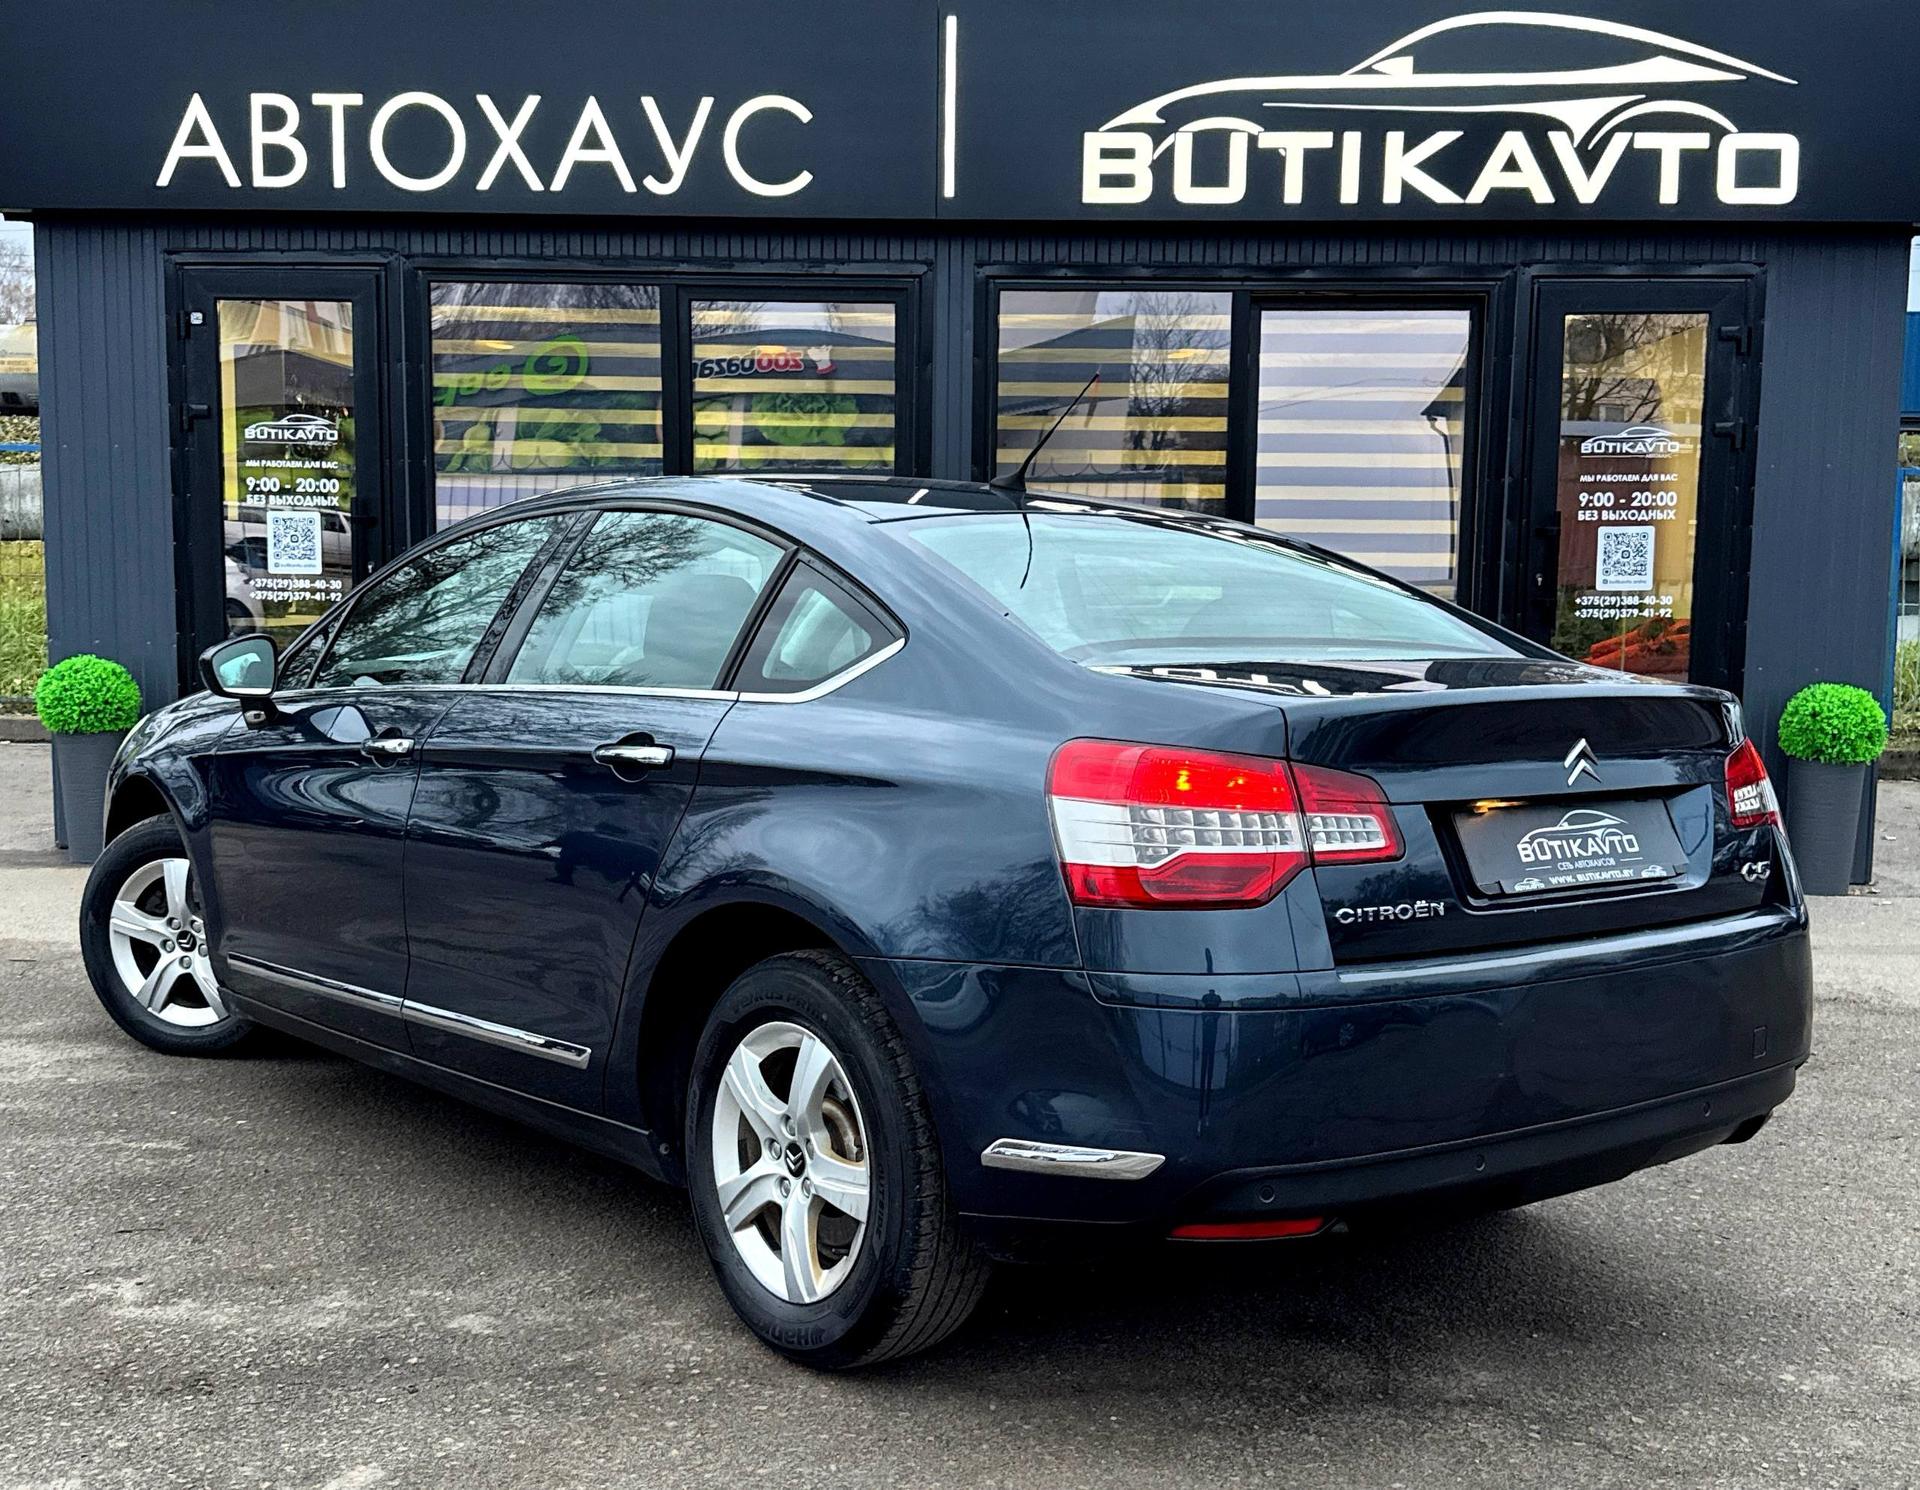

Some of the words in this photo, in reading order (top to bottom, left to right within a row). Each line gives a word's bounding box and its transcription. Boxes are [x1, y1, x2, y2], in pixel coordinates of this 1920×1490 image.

[156, 91, 814, 198] АВТОХАУС
[1081, 131, 1799, 205] BUTIKAVTO
[244, 428, 339, 440] BUTIKAVTO
[1581, 441, 1680, 453] BUTIKAVTO
[321, 461, 339, 469] ВАС
[1580, 474, 1594, 482] МЫ
[1596, 474, 1640, 482] РАБОТАЕМ
[1641, 473, 1658, 482] ДЛЯ
[1660, 473, 1678, 481] ВАС
[246, 476, 280, 492] 9:00
[295, 477, 340, 493] 20:00
[246, 494, 266, 505] БЕЗ
[268, 494, 340, 507] ВЫХОДНЫХ
[1578, 491, 1615, 507] 9:00
[1630, 491, 1678, 506] 20:00
[1577, 510, 1599, 521] БЕЗ
[1601, 509, 1676, 521] ВЫХОДНЫХ
[249, 578, 342, 589] +375(29)388-40-30
[249, 590, 342, 602] +375(29)379-41-92
[1574, 595, 1673, 607] +375(29)388-40-30
[1574, 608, 1672, 620] +375(29)379-41-92
[1516, 833, 1640, 863] BUTIKAVTO
[1740, 860, 1771, 882] C5
[1335, 900, 1445, 924] CITROËN
